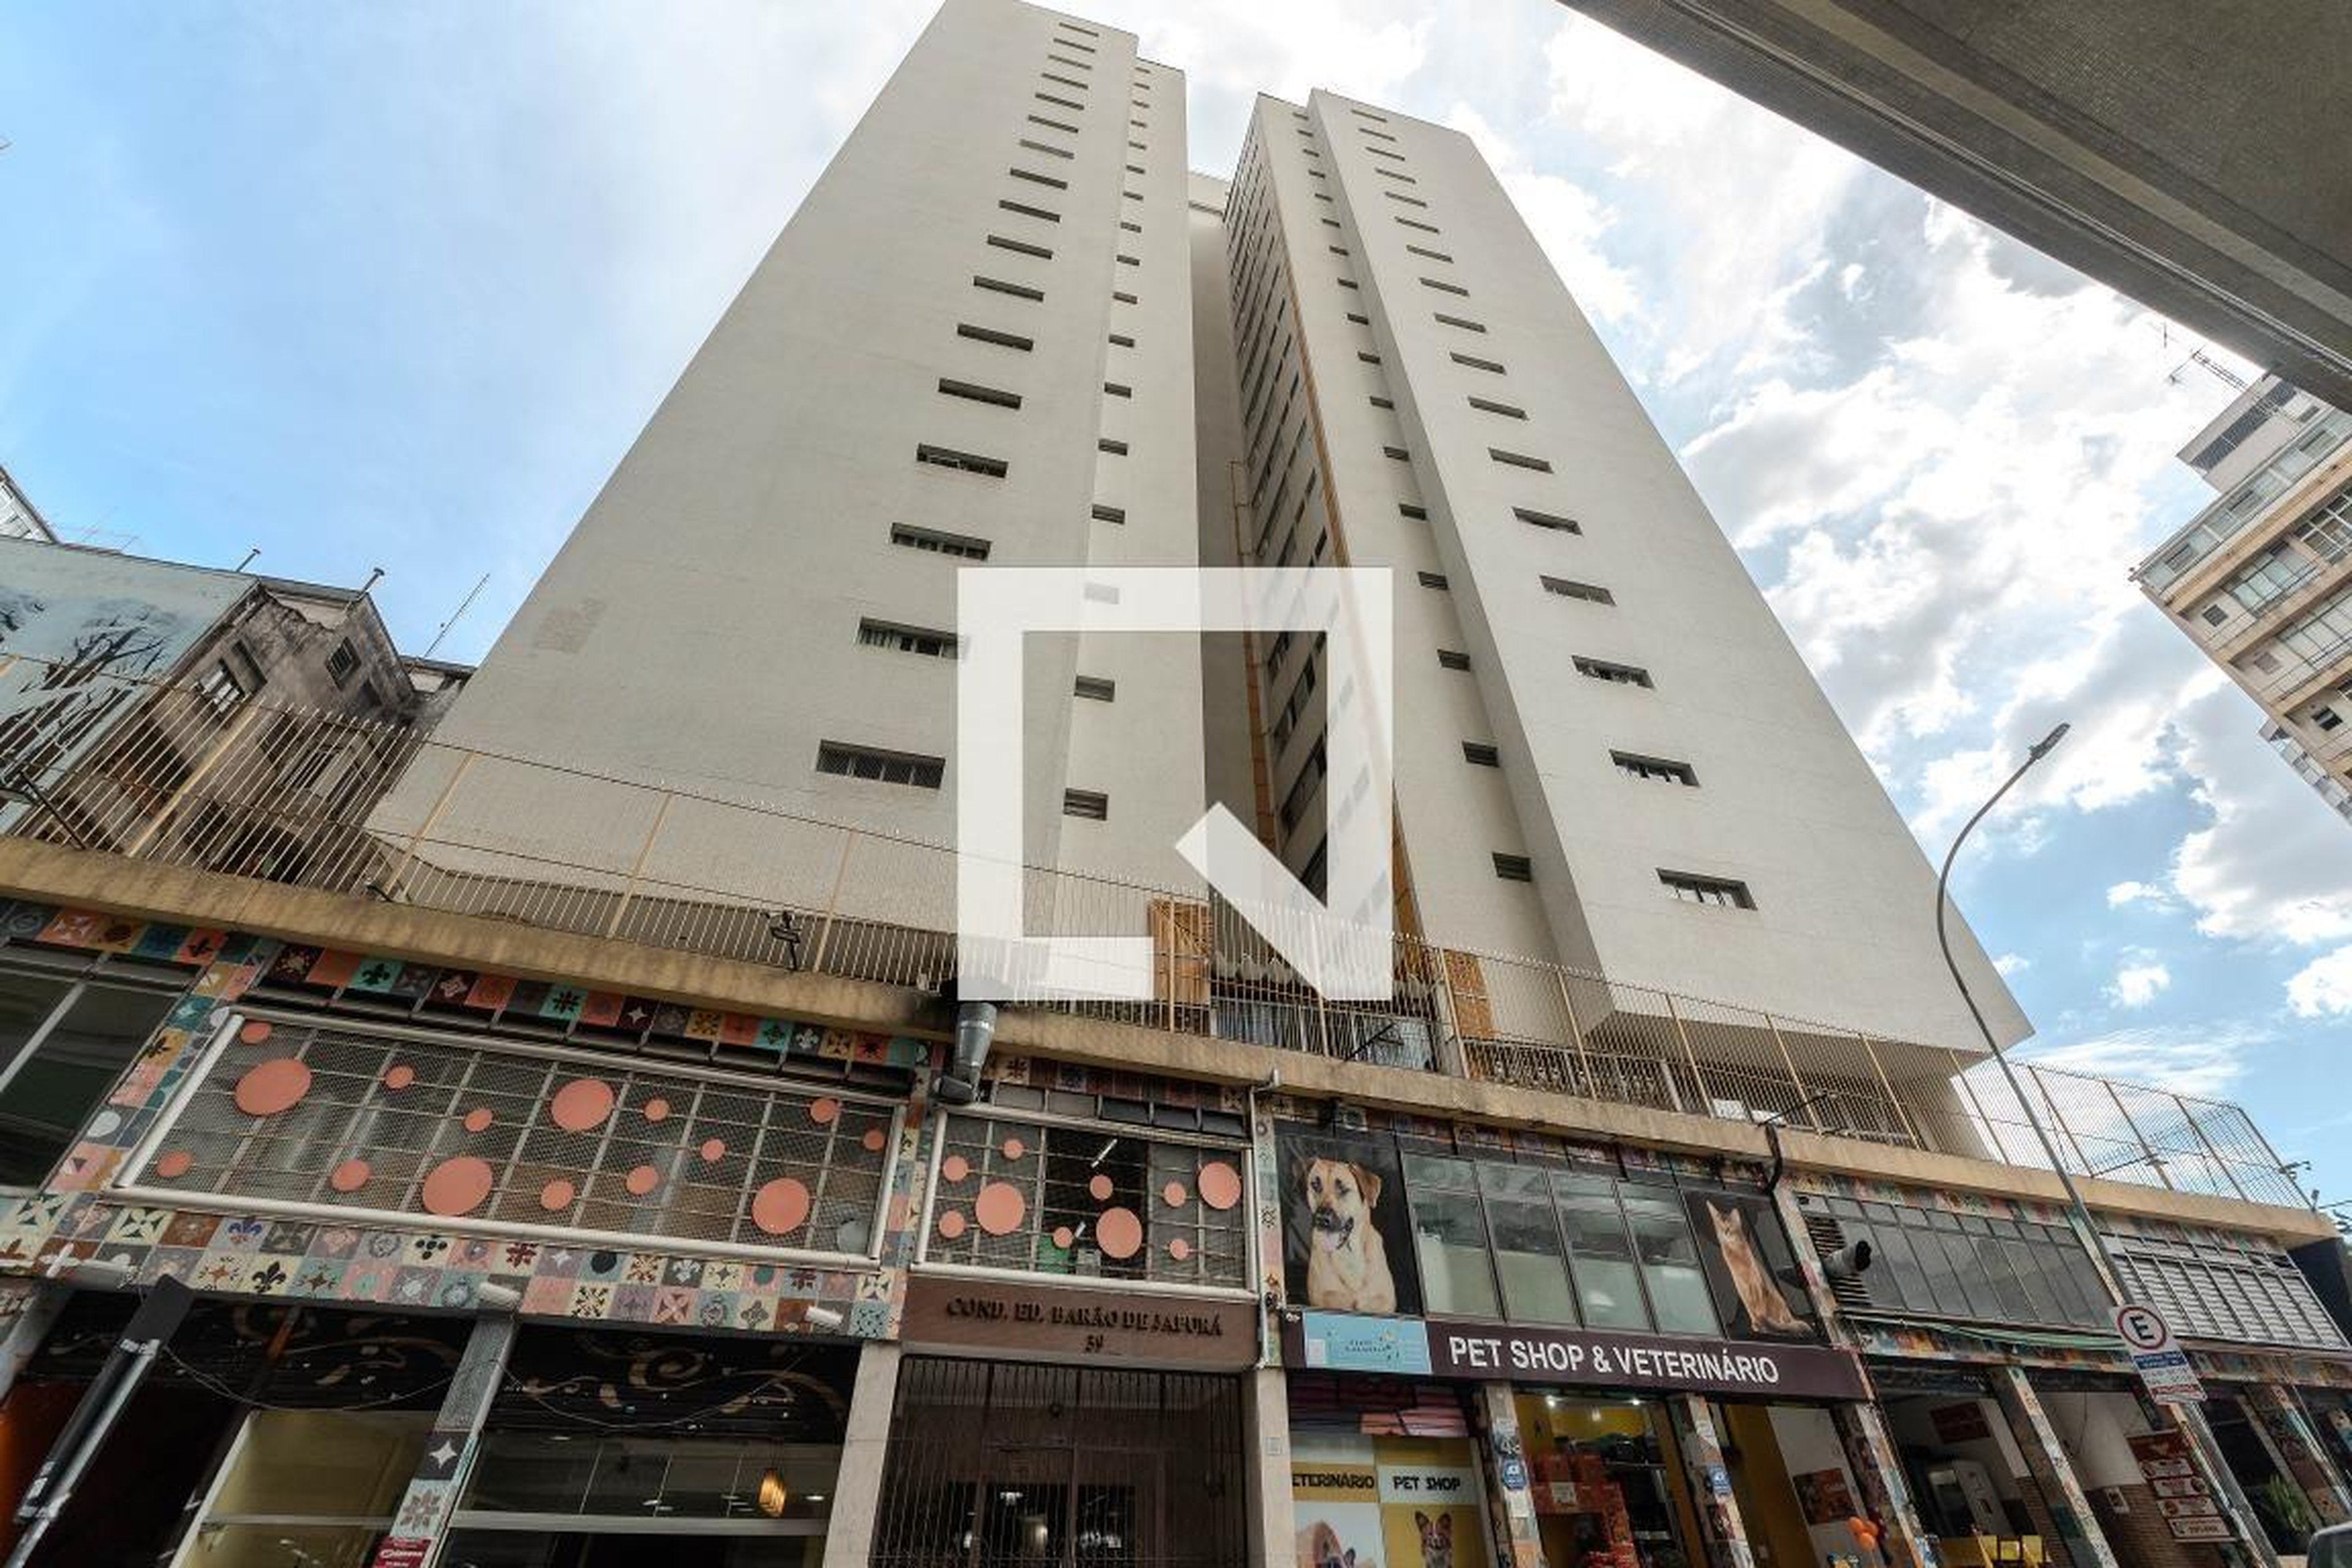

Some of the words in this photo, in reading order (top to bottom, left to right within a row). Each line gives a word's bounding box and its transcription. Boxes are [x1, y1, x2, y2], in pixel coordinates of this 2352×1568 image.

[947, 1298, 1008, 1320] COND.
[1051, 1306, 1118, 1328] BARÃO
[1122, 1311, 1148, 1331] DE
[2130, 1316, 2156, 1340] E
[1449, 1336, 1502, 1368] PET
[1509, 1339, 1585, 1373] SHOP
[1592, 1346, 1612, 1374] &
[1613, 1347, 1780, 1384] VETERINÁRIO
[1393, 1476, 1420, 1490] PET
[1426, 1476, 1461, 1491] SHOP
